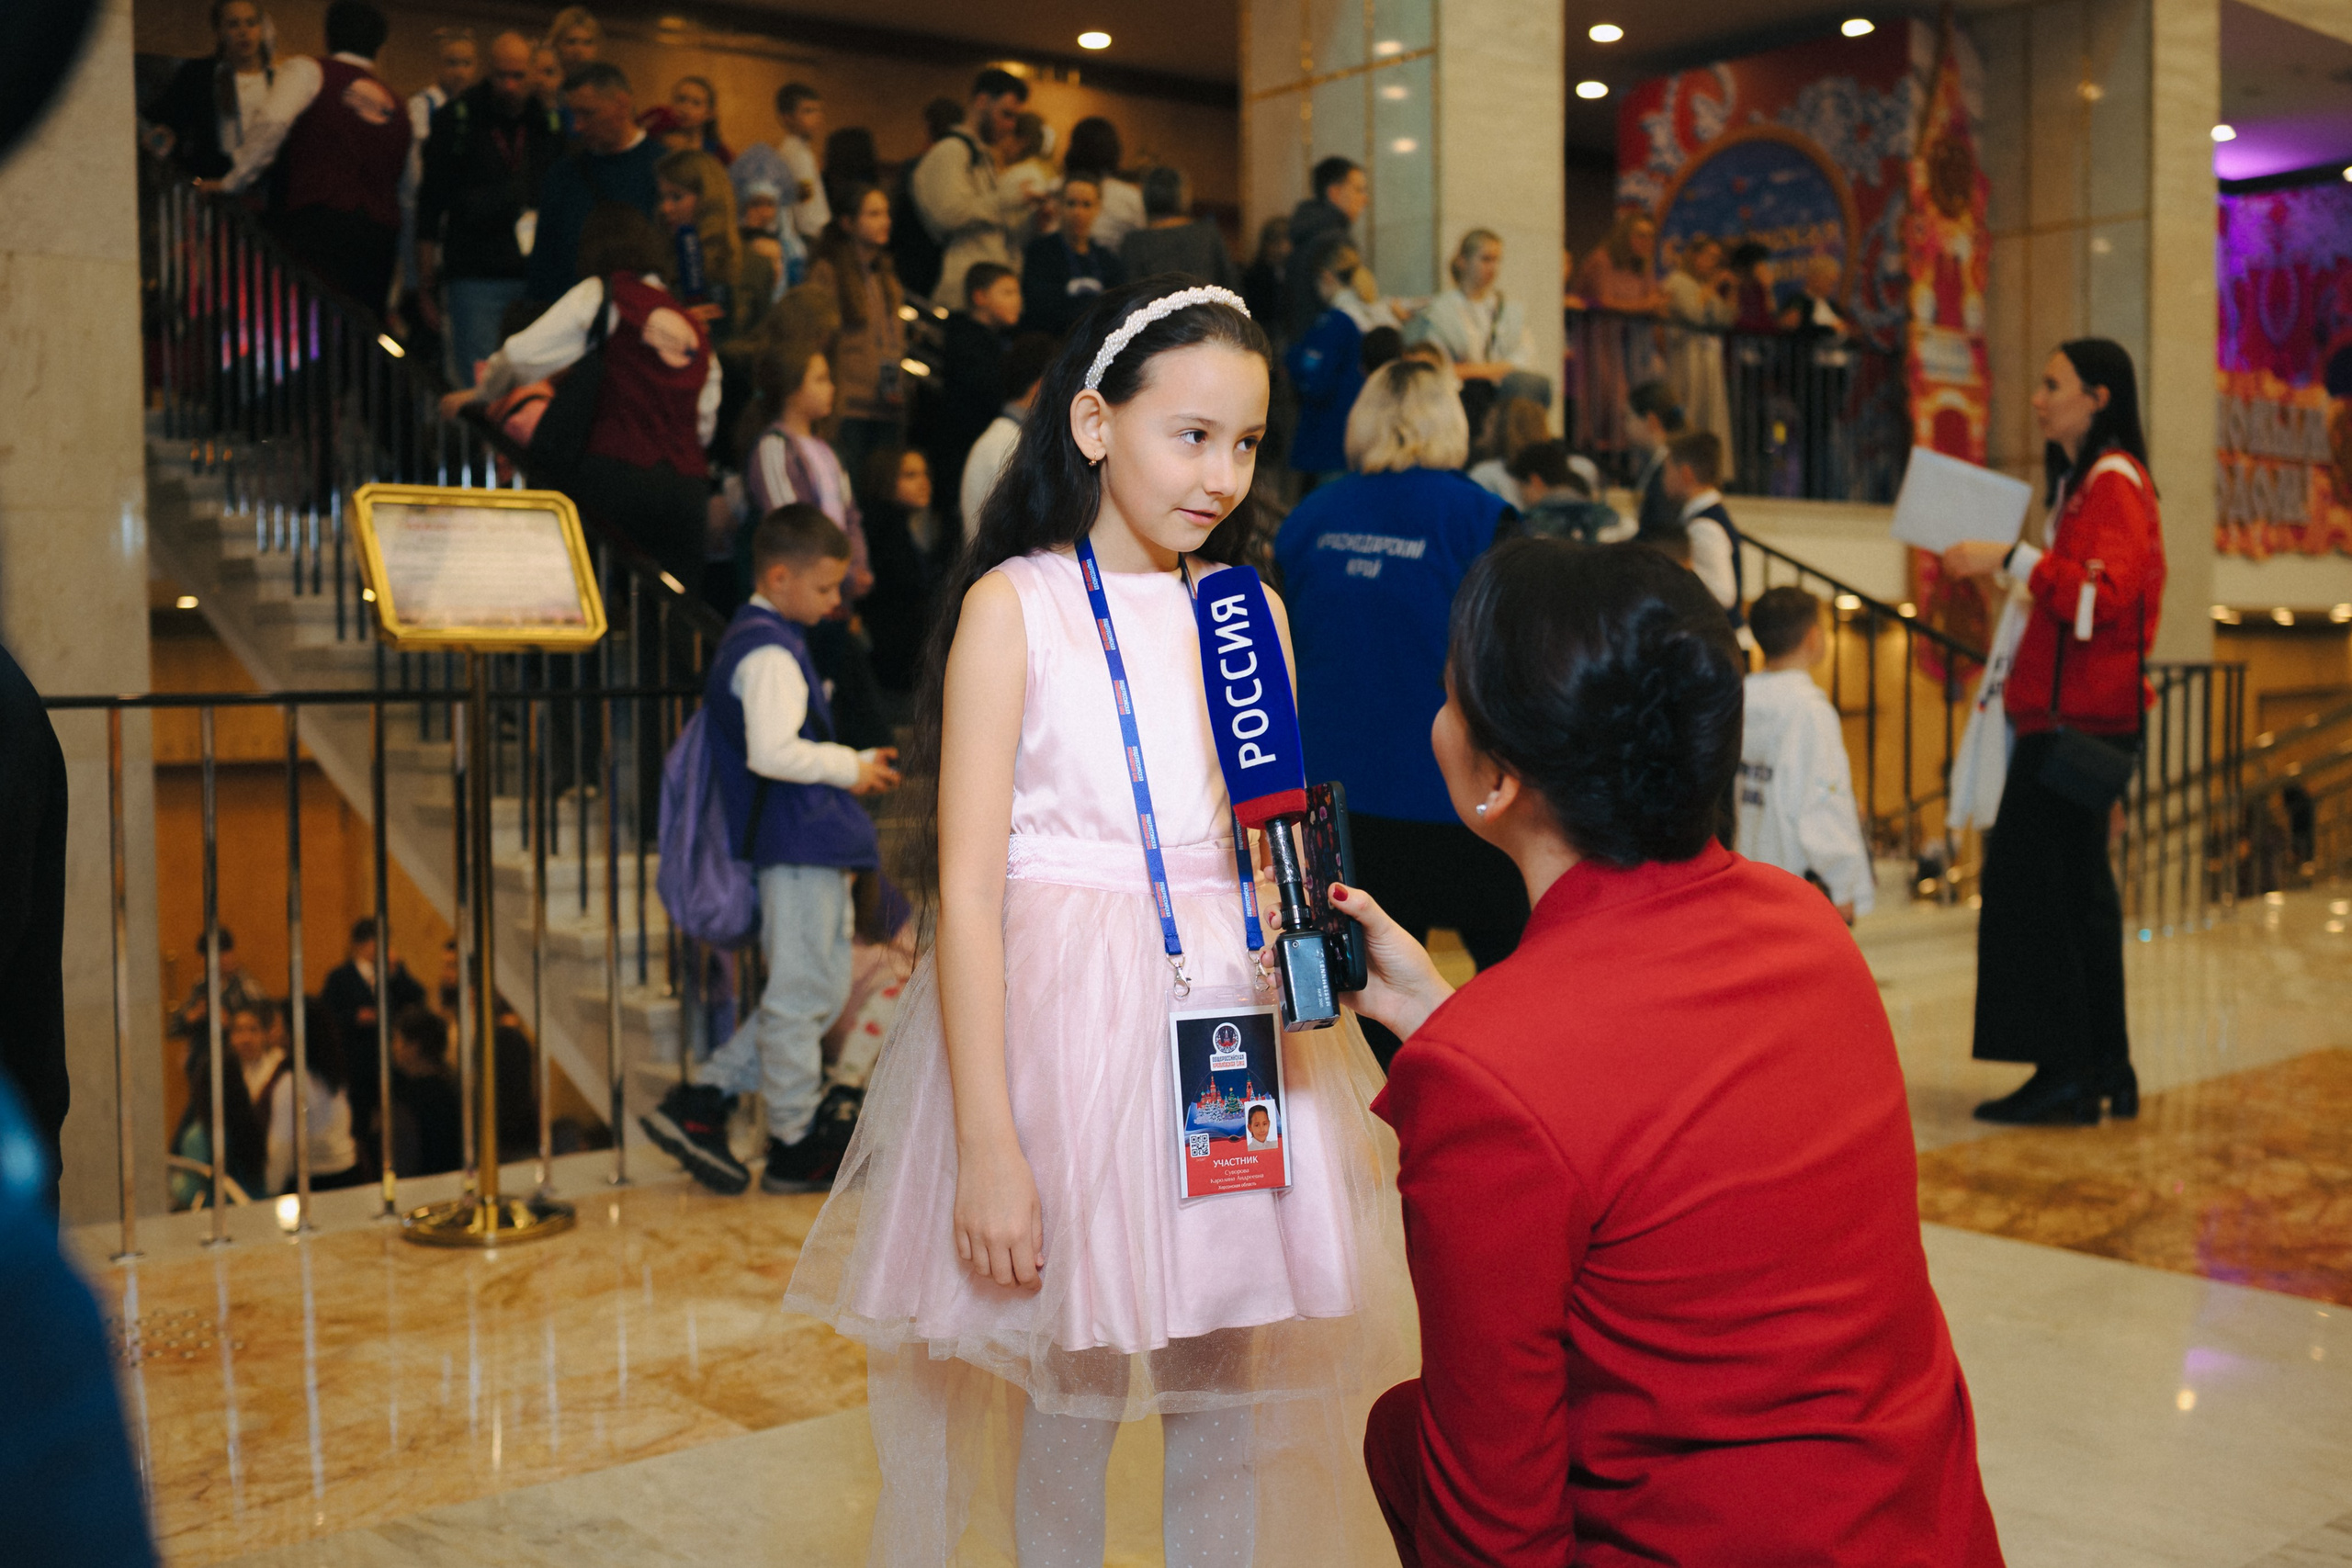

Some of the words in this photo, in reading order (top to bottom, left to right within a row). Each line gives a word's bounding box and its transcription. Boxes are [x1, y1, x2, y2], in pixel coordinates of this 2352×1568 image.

[1211, 593, 1276, 770] РОССИЯ
[1319, 960, 1330, 1006] SENNHEISER
[1213, 1156, 1259, 1168] УЧАСТНИК
